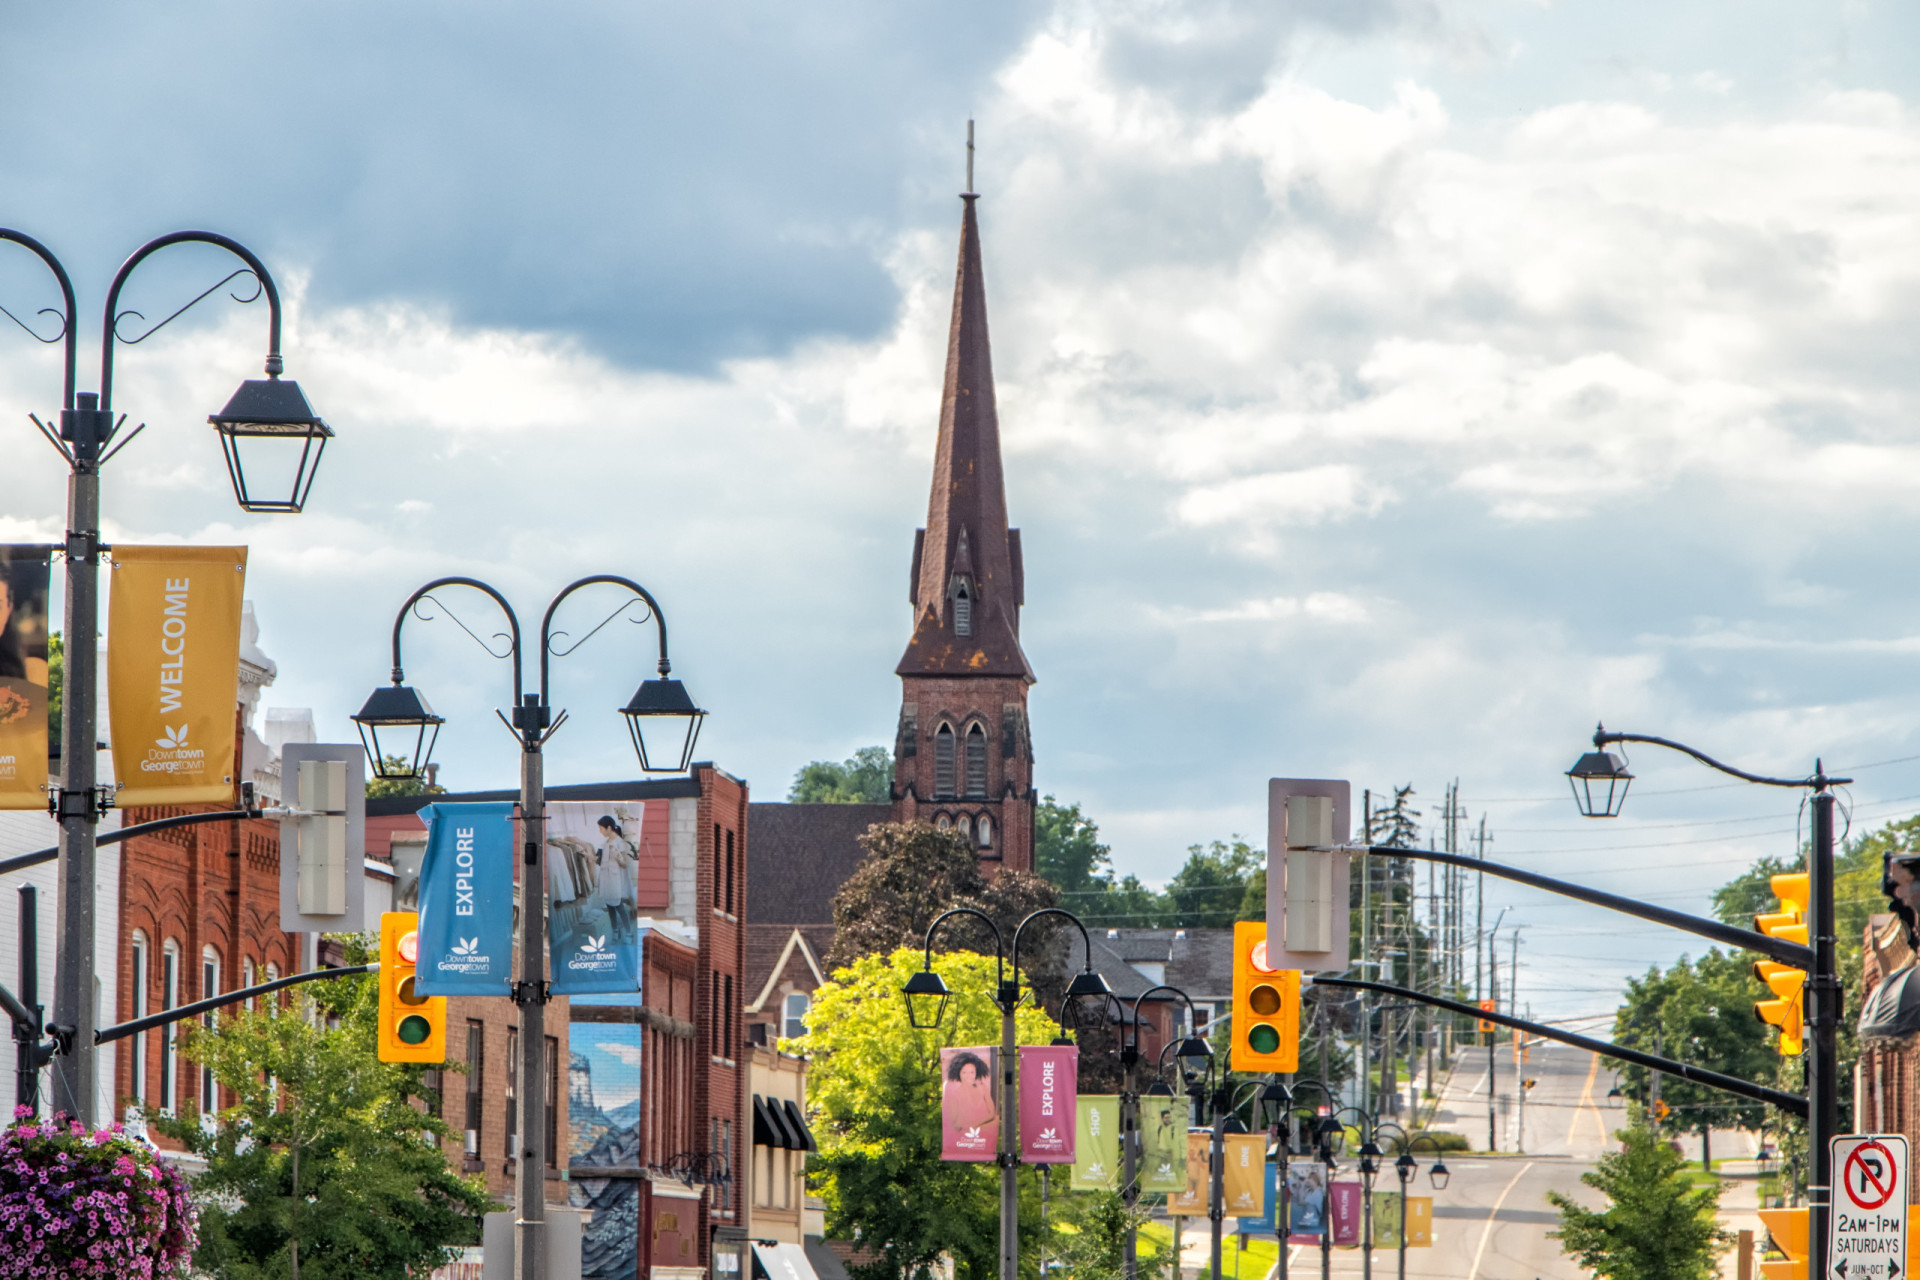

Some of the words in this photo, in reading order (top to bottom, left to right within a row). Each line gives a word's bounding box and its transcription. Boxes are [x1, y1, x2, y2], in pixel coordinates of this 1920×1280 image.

[160, 578, 189, 713] WELCOME
[148, 748, 204, 760] Downtown
[141, 760, 205, 773] Georgetown
[456, 827, 474, 916] EXPLORE
[445, 953, 490, 963] Downtown
[574, 952, 616, 961] Downtown
[438, 961, 490, 973] Georgetown
[568, 960, 616, 971] Georgetown
[1042, 1061, 1055, 1116] EXPLORE
[1090, 1107, 1101, 1137] SHOP
[1240, 1145, 1250, 1167] DINE
[1838, 1214, 1900, 1233] 2AM-1PM
[1837, 1238, 1899, 1254] SATURDAYS
[1851, 1265, 1884, 1275] JUN-OCT
